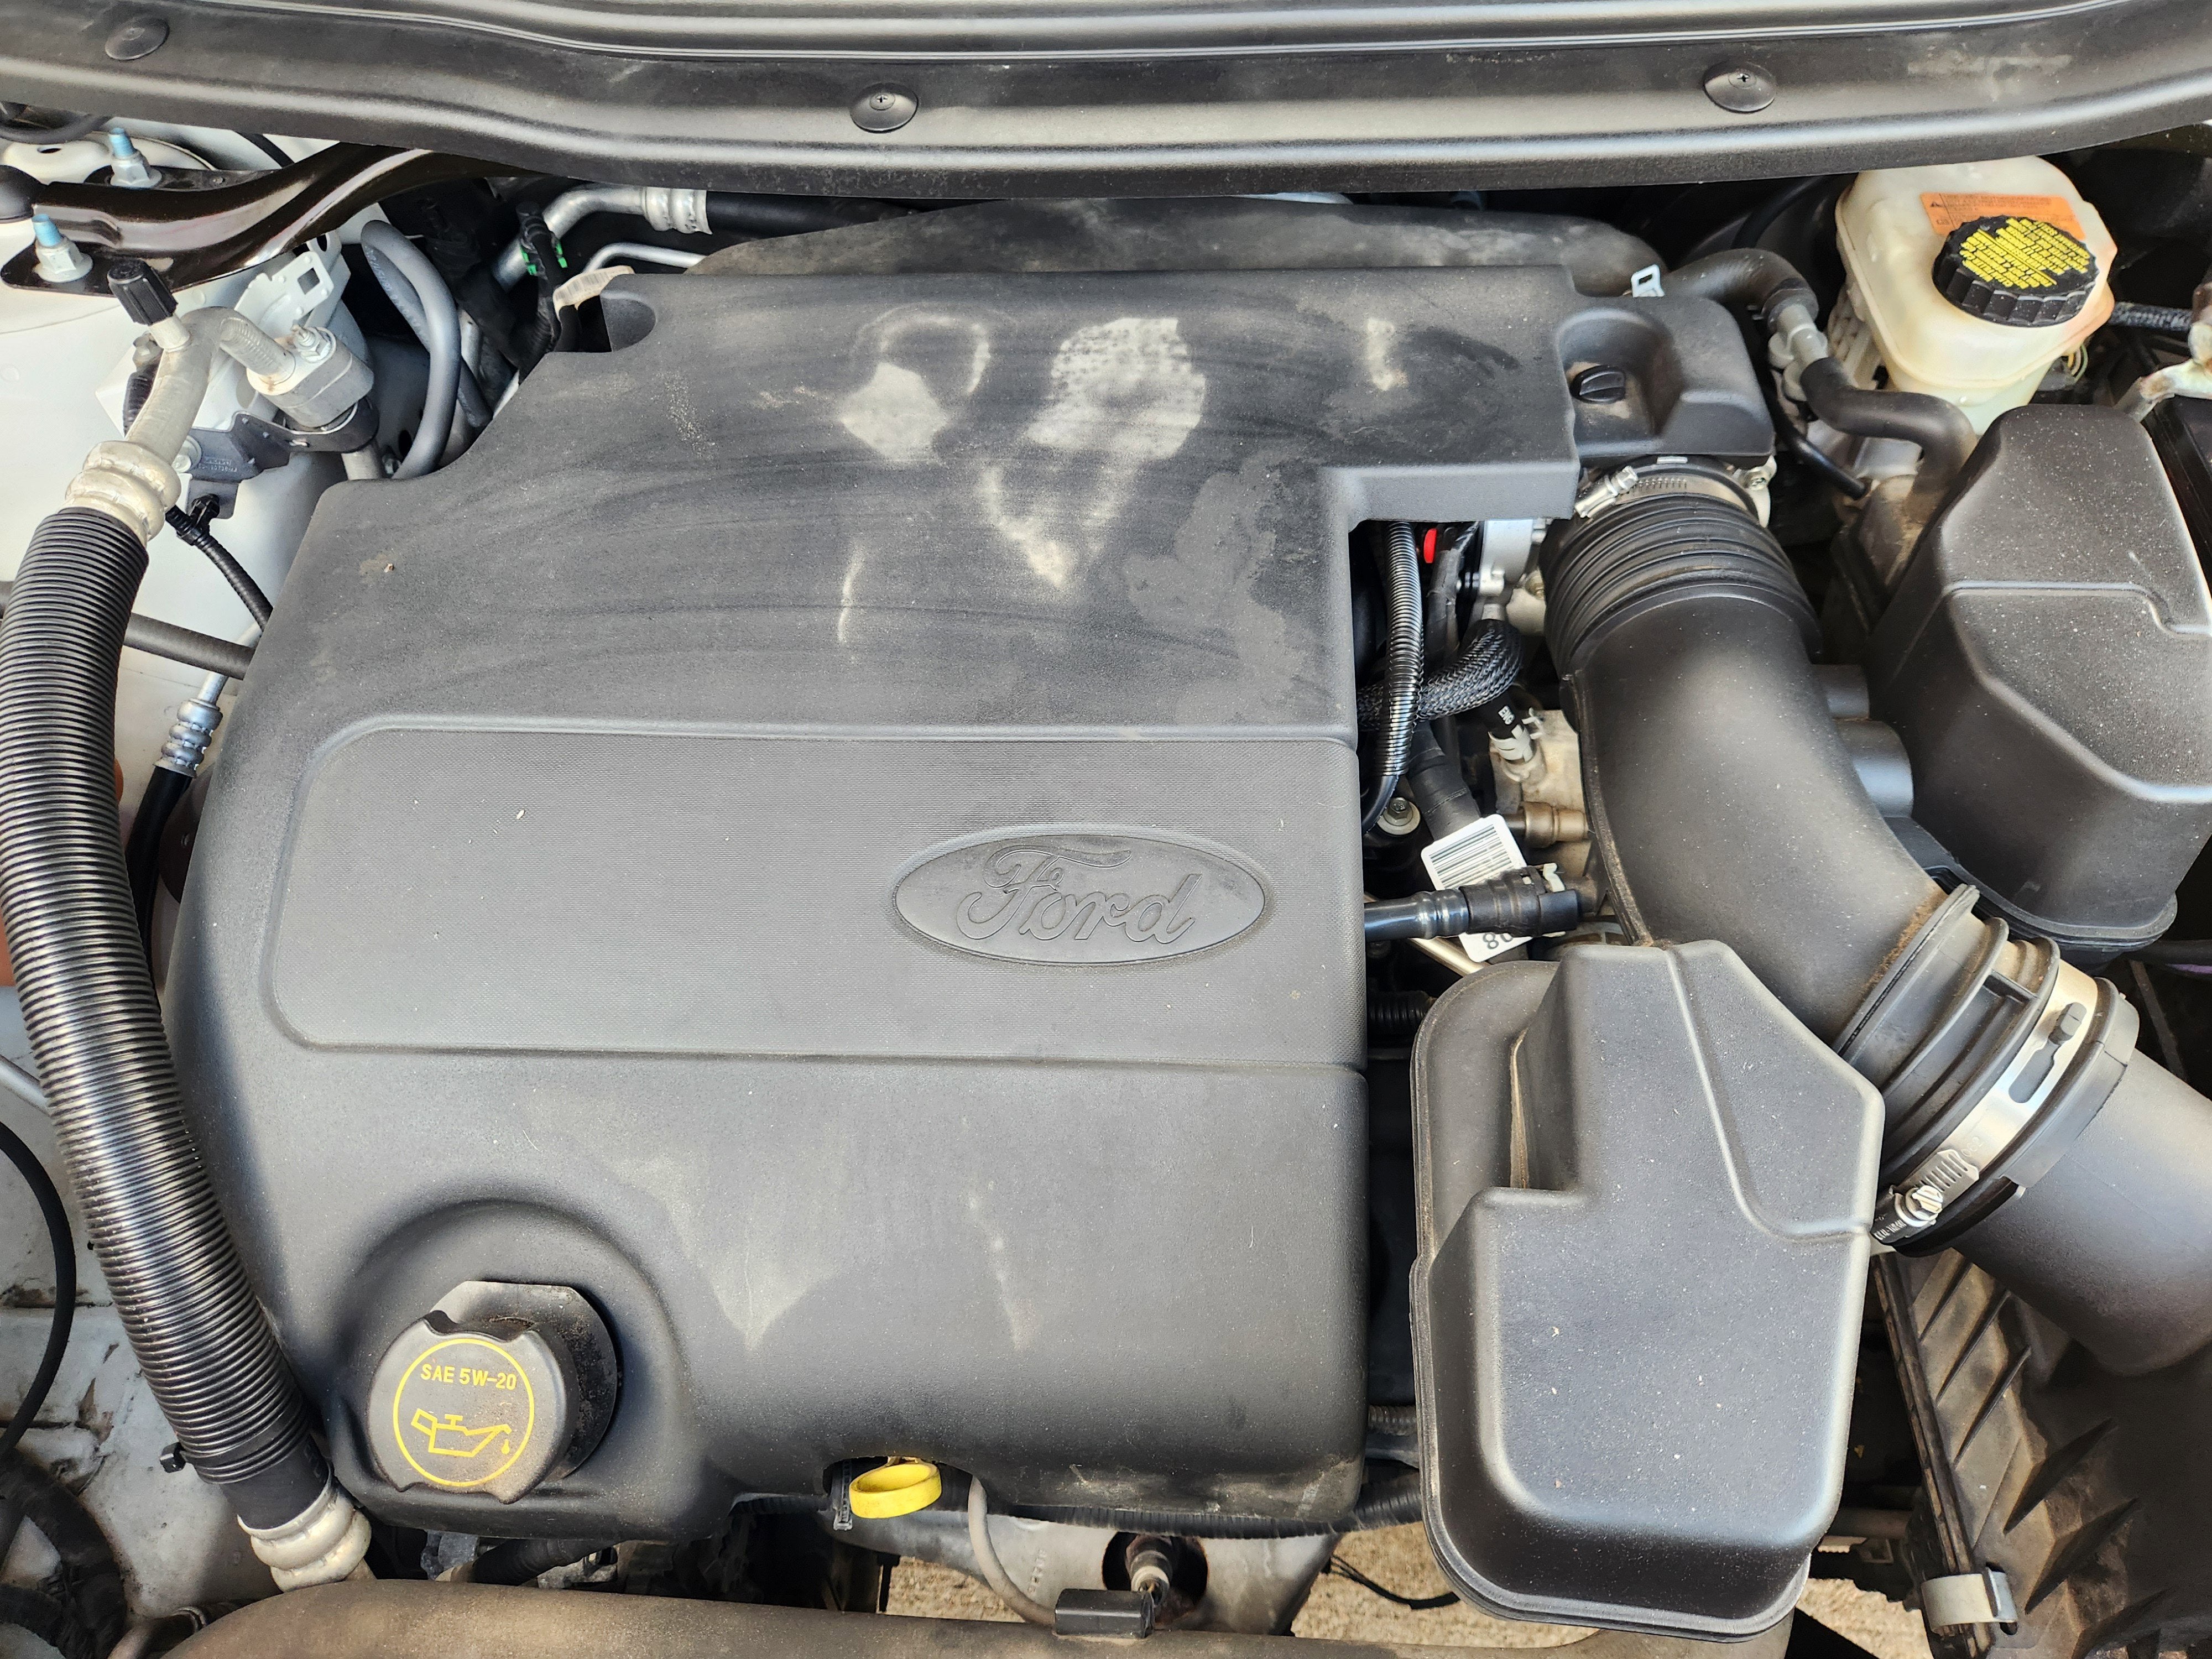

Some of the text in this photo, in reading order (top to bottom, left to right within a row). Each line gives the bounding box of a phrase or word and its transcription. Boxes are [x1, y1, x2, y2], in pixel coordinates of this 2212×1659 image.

[1498, 705, 1515, 725] ENG
[956, 845, 1203, 945] Ford
[420, 1364, 517, 1390] SAE 5W-20
